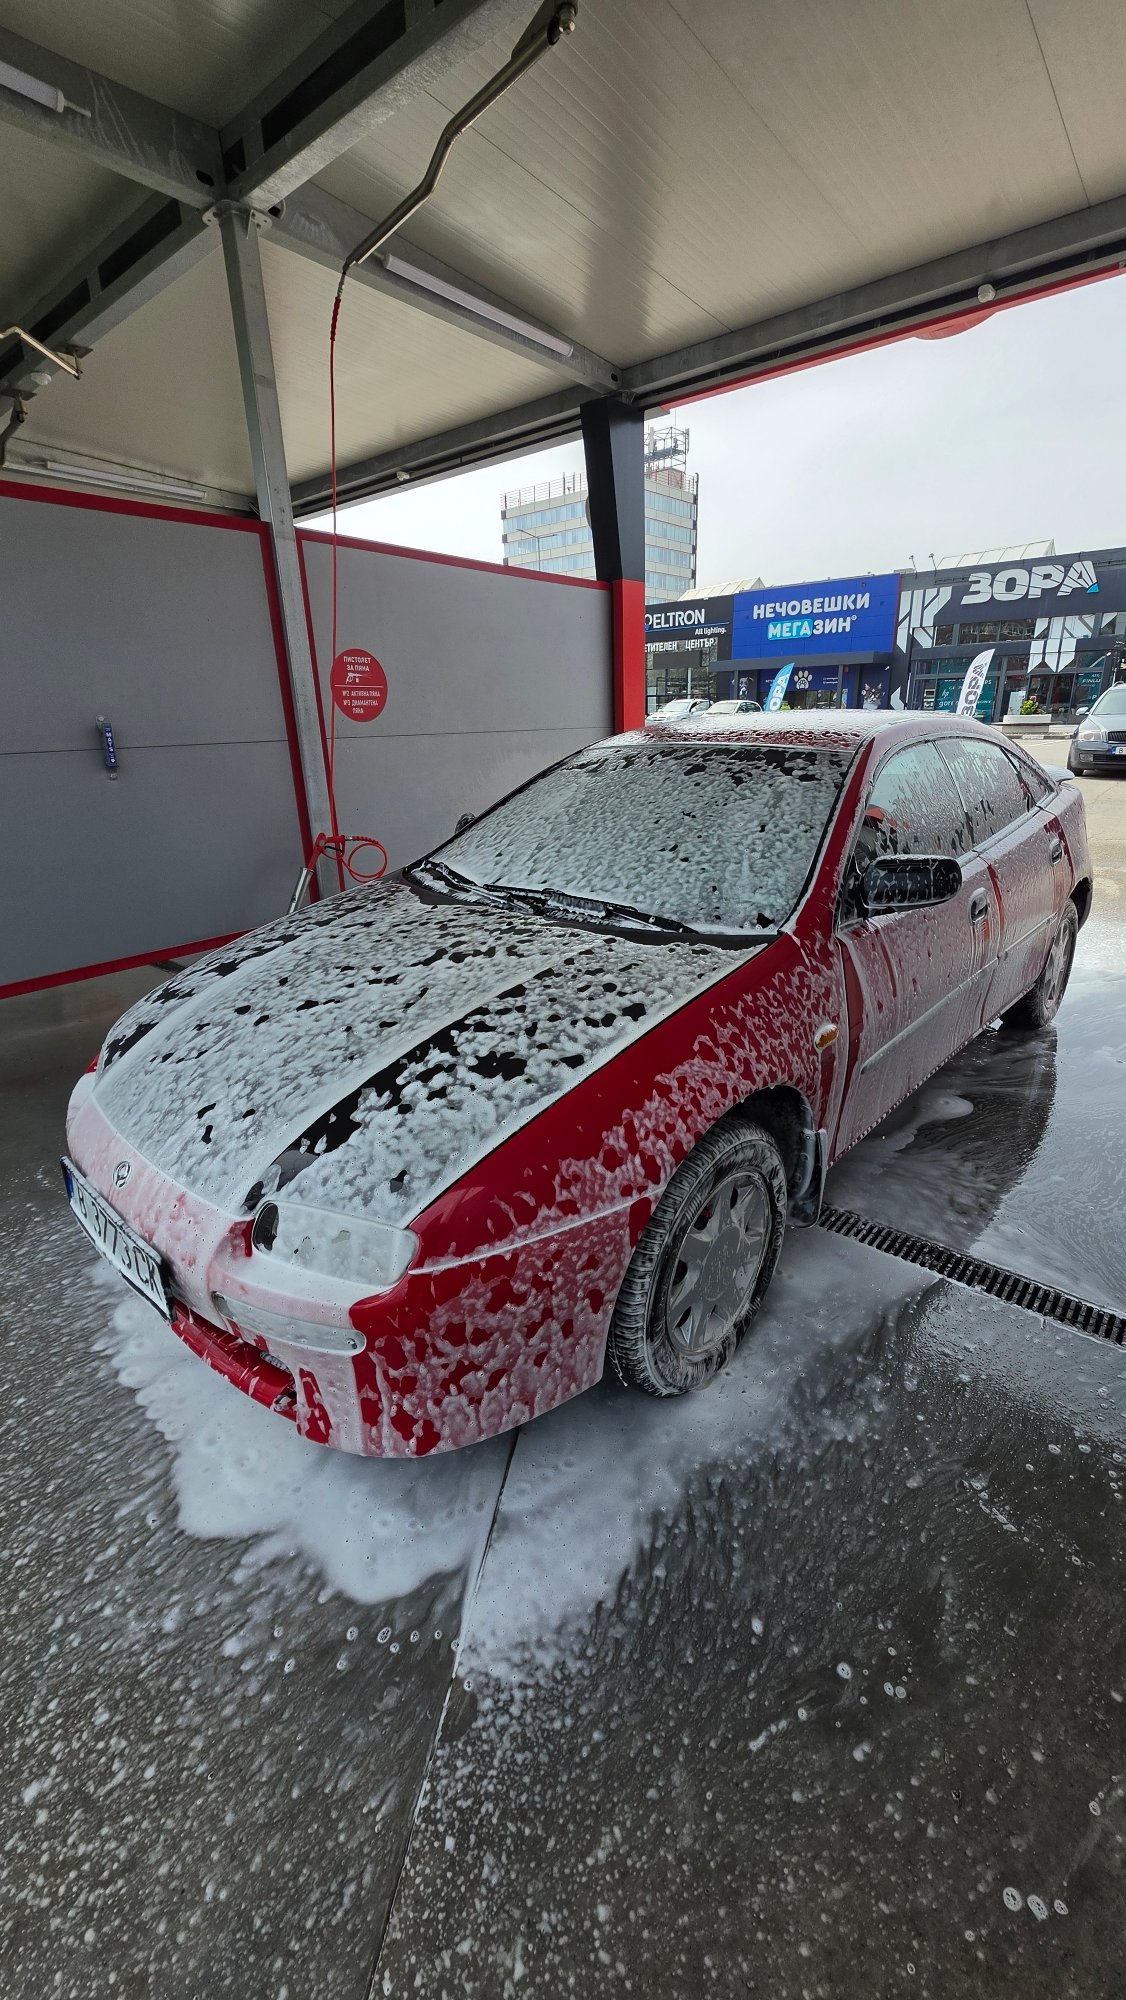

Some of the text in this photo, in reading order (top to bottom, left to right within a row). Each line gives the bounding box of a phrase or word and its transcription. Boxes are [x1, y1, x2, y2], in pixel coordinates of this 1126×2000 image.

[961, 561, 1099, 605] ЗОРА
[753, 592, 871, 620] НЕЧОВЕШКИ
[768, 616, 852, 639] МЕГАЗИН
[685, 637, 714, 651] ЦЕНТЪР
